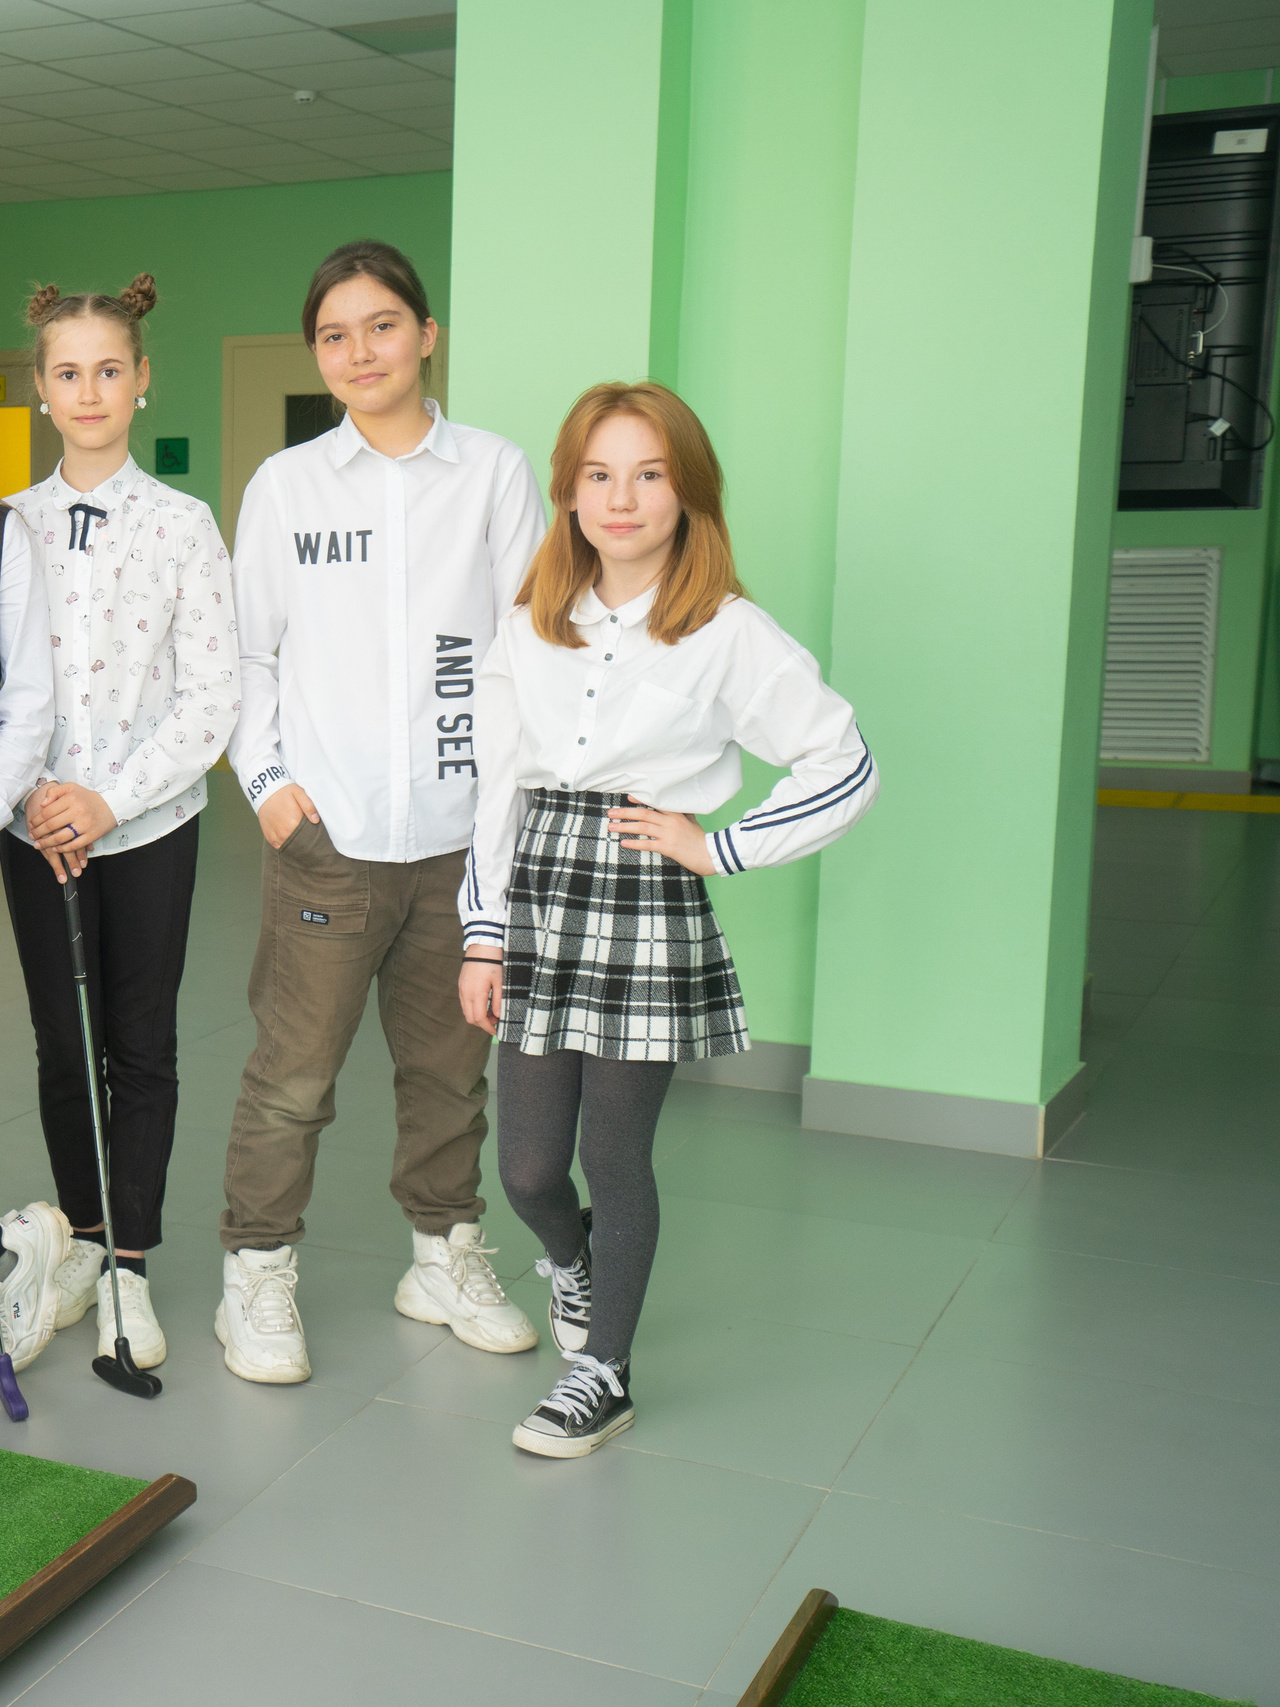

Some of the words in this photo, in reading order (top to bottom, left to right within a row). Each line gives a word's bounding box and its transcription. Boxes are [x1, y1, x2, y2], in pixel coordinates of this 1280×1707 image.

[294, 529, 373, 565] WAIT
[435, 634, 474, 699] AND
[436, 713, 479, 780] SEE
[13, 1302, 21, 1319] FILA
